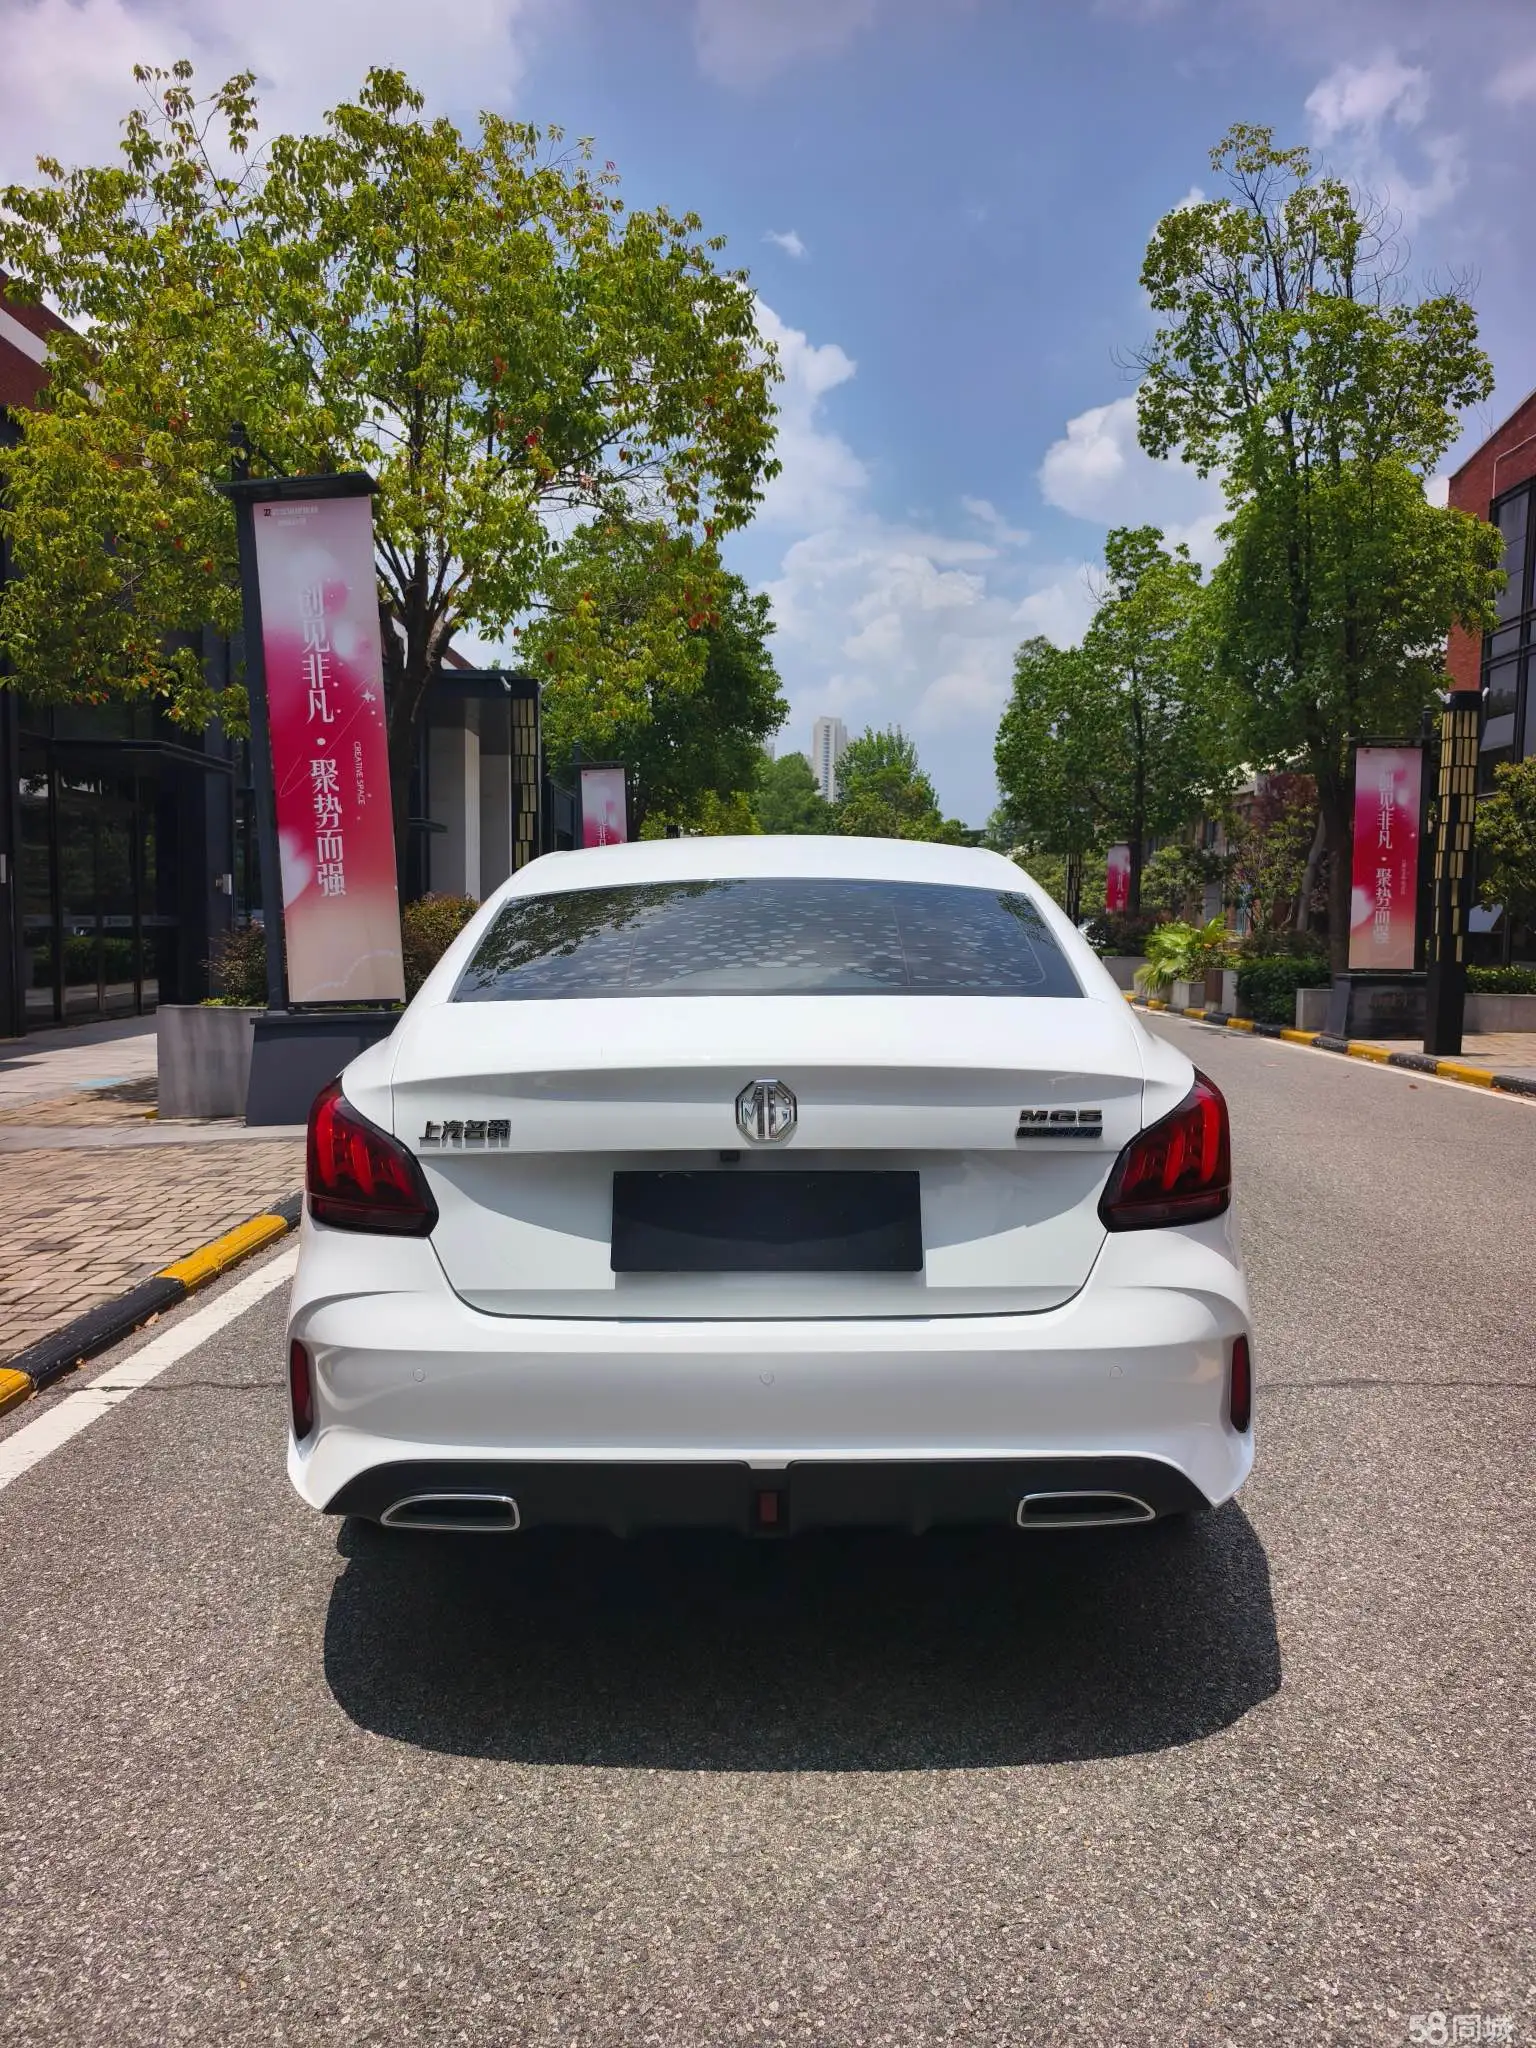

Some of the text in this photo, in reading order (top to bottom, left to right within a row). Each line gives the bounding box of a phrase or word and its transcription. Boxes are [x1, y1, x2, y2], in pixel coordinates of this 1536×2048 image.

[354, 741, 366, 805] CREATIVE SPACE
[419, 1119, 511, 1141] 上汽名爵
[741, 1086, 792, 1138] MG
